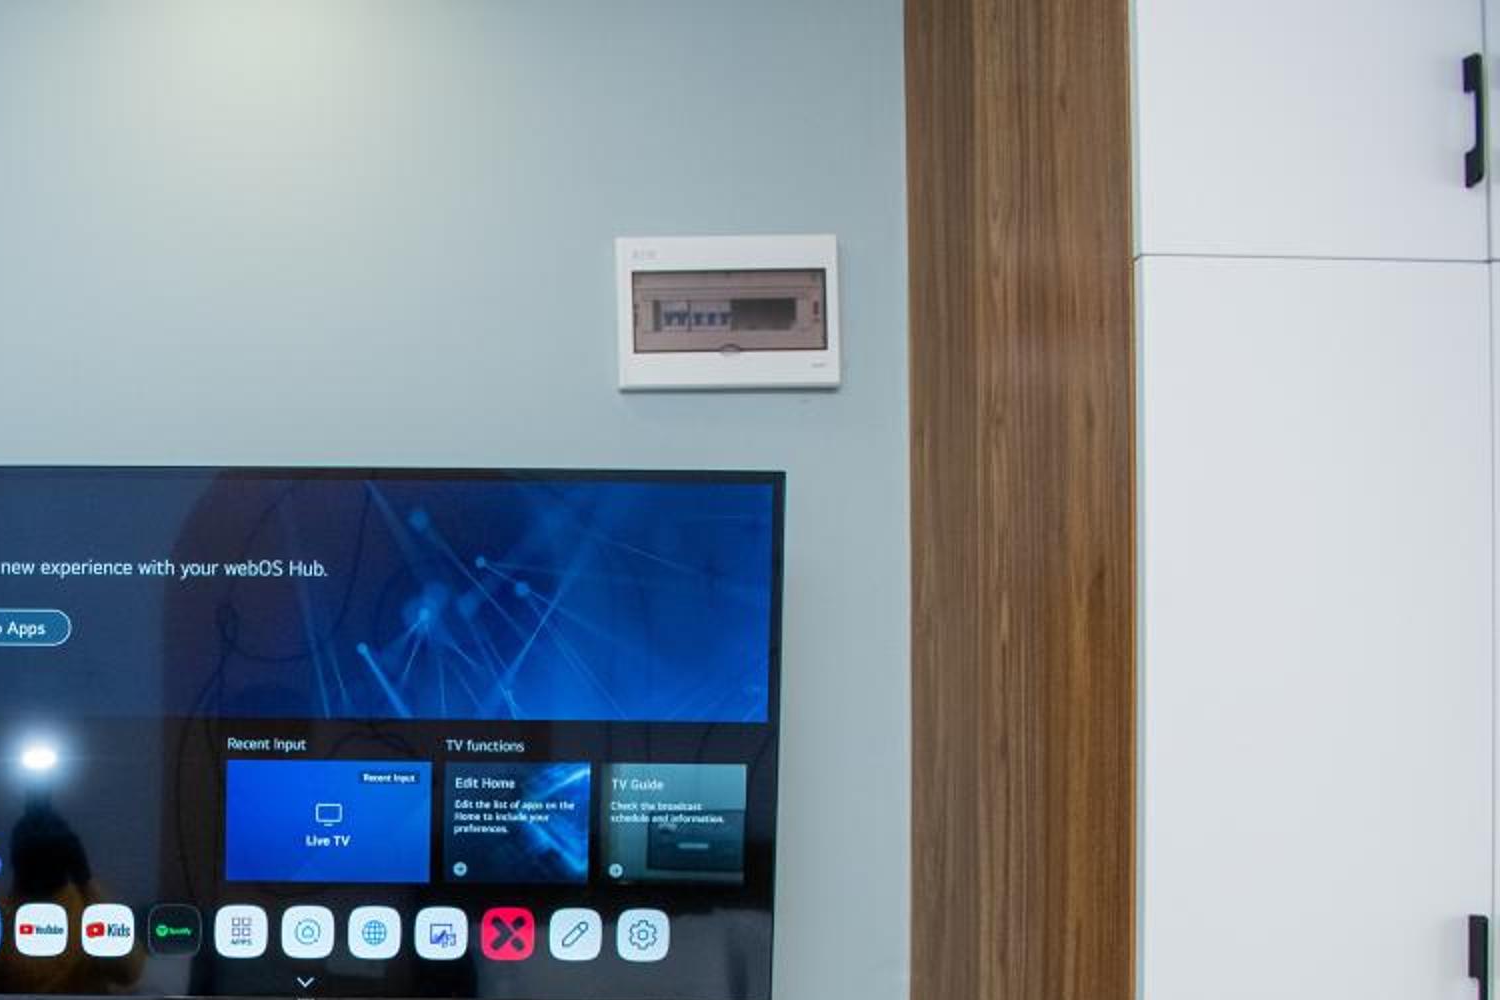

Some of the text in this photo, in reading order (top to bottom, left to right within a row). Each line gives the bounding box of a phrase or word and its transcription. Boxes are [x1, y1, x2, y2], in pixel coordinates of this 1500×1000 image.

[1, 562, 35, 575] new
[40, 558, 133, 579] experience
[137, 559, 175, 576] with
[179, 562, 219, 580] your
[224, 559, 283, 577] webOS
[289, 559, 328, 577] Hub.
[7, 621, 46, 639] Apps
[227, 737, 307, 752] Recent Input
[446, 739, 525, 752] TV functions
[363, 773, 416, 784] Recent Input
[455, 777, 516, 789] Edit Home
[612, 779, 664, 791] TV Guide
[306, 835, 351, 847] Live TV
[35, 925, 64, 936] YouTube
[107, 924, 131, 937] Kids
